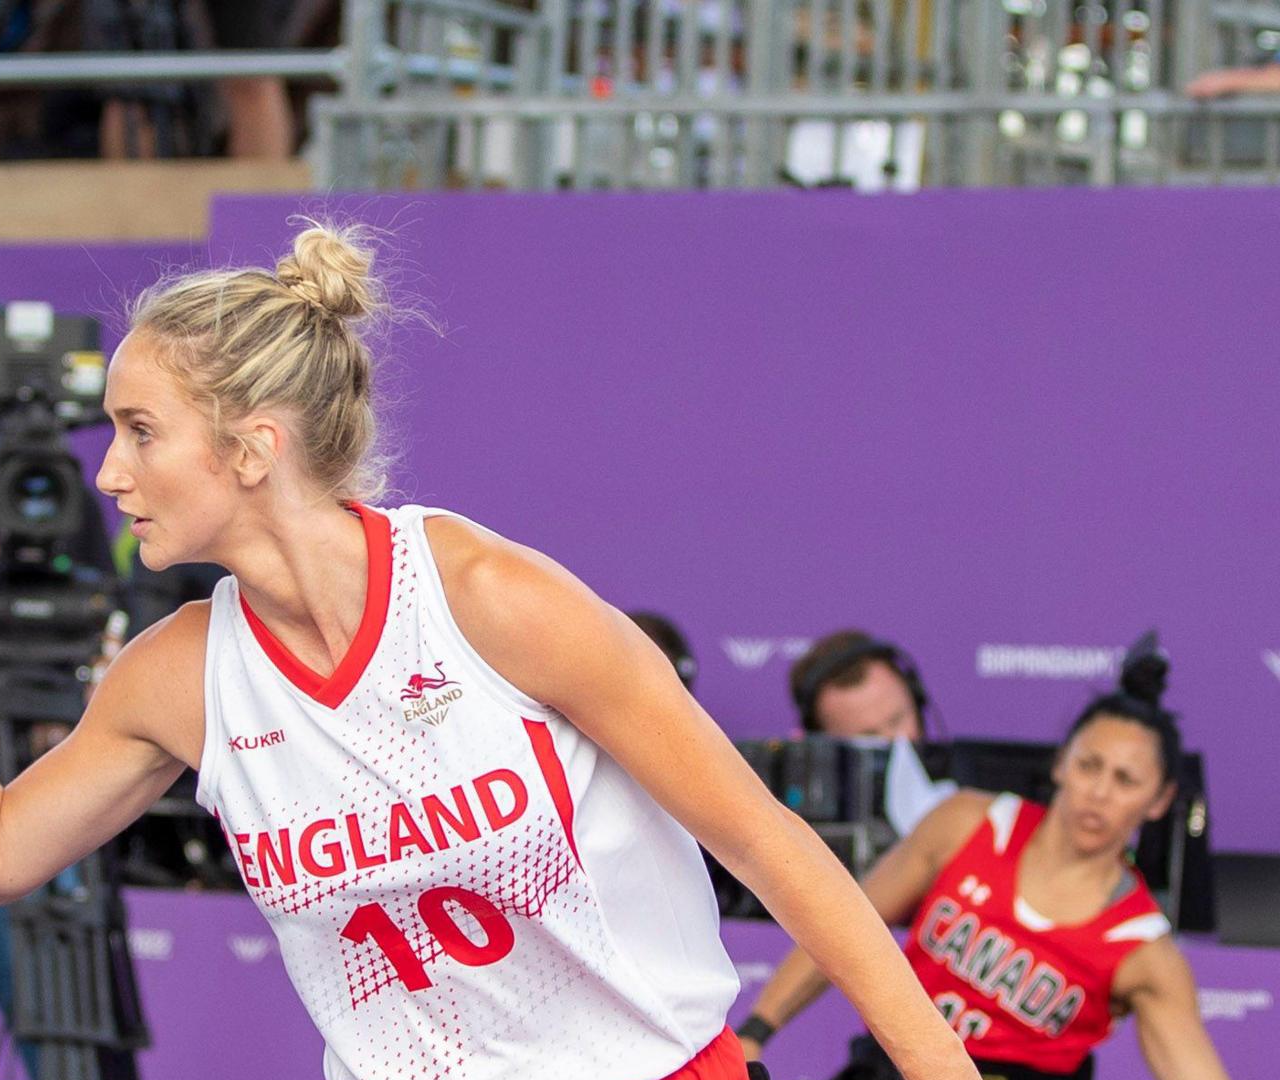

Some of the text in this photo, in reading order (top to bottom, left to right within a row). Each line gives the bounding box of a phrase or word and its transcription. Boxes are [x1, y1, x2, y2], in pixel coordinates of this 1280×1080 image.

[228, 729, 286, 753] KUKRI
[403, 688, 463, 722] ENGLAND
[235, 767, 529, 888] ENGLAND
[340, 885, 516, 993] 10
[918, 897, 1087, 1038] CANADA
